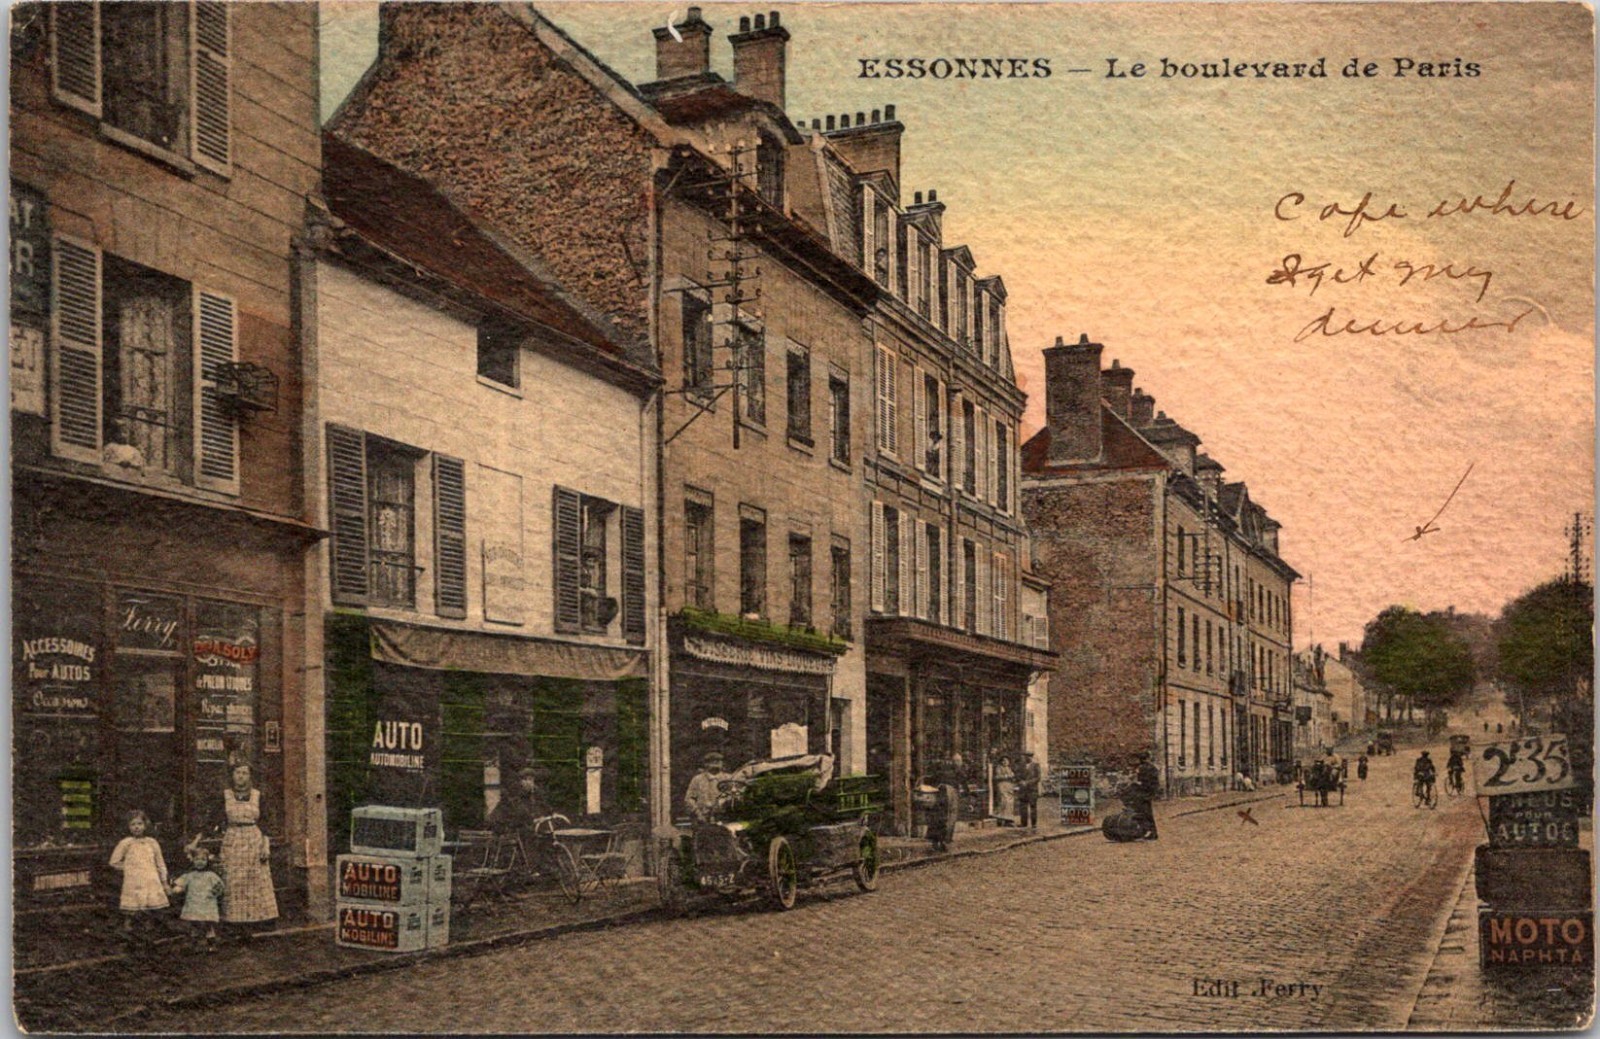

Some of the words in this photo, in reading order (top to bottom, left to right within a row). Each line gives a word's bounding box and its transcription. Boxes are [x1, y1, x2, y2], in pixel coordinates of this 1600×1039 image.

[1394, 260, 1493, 304] my
[22, 636, 96, 662] ACCESSOIRES
[51, 663, 91, 681] AUTOS
[372, 720, 422, 750] AUTO
[1061, 769, 1089, 778] MOTO
[1061, 808, 1089, 817] MOTO
[344, 863, 396, 884] AUTO
[342, 882, 398, 900] MOBILINE
[344, 909, 394, 929] AUTO
[341, 928, 396, 946] MOBILINE
[1489, 917, 1586, 946] MOTO
[1489, 948, 1584, 965] NAPHTA
